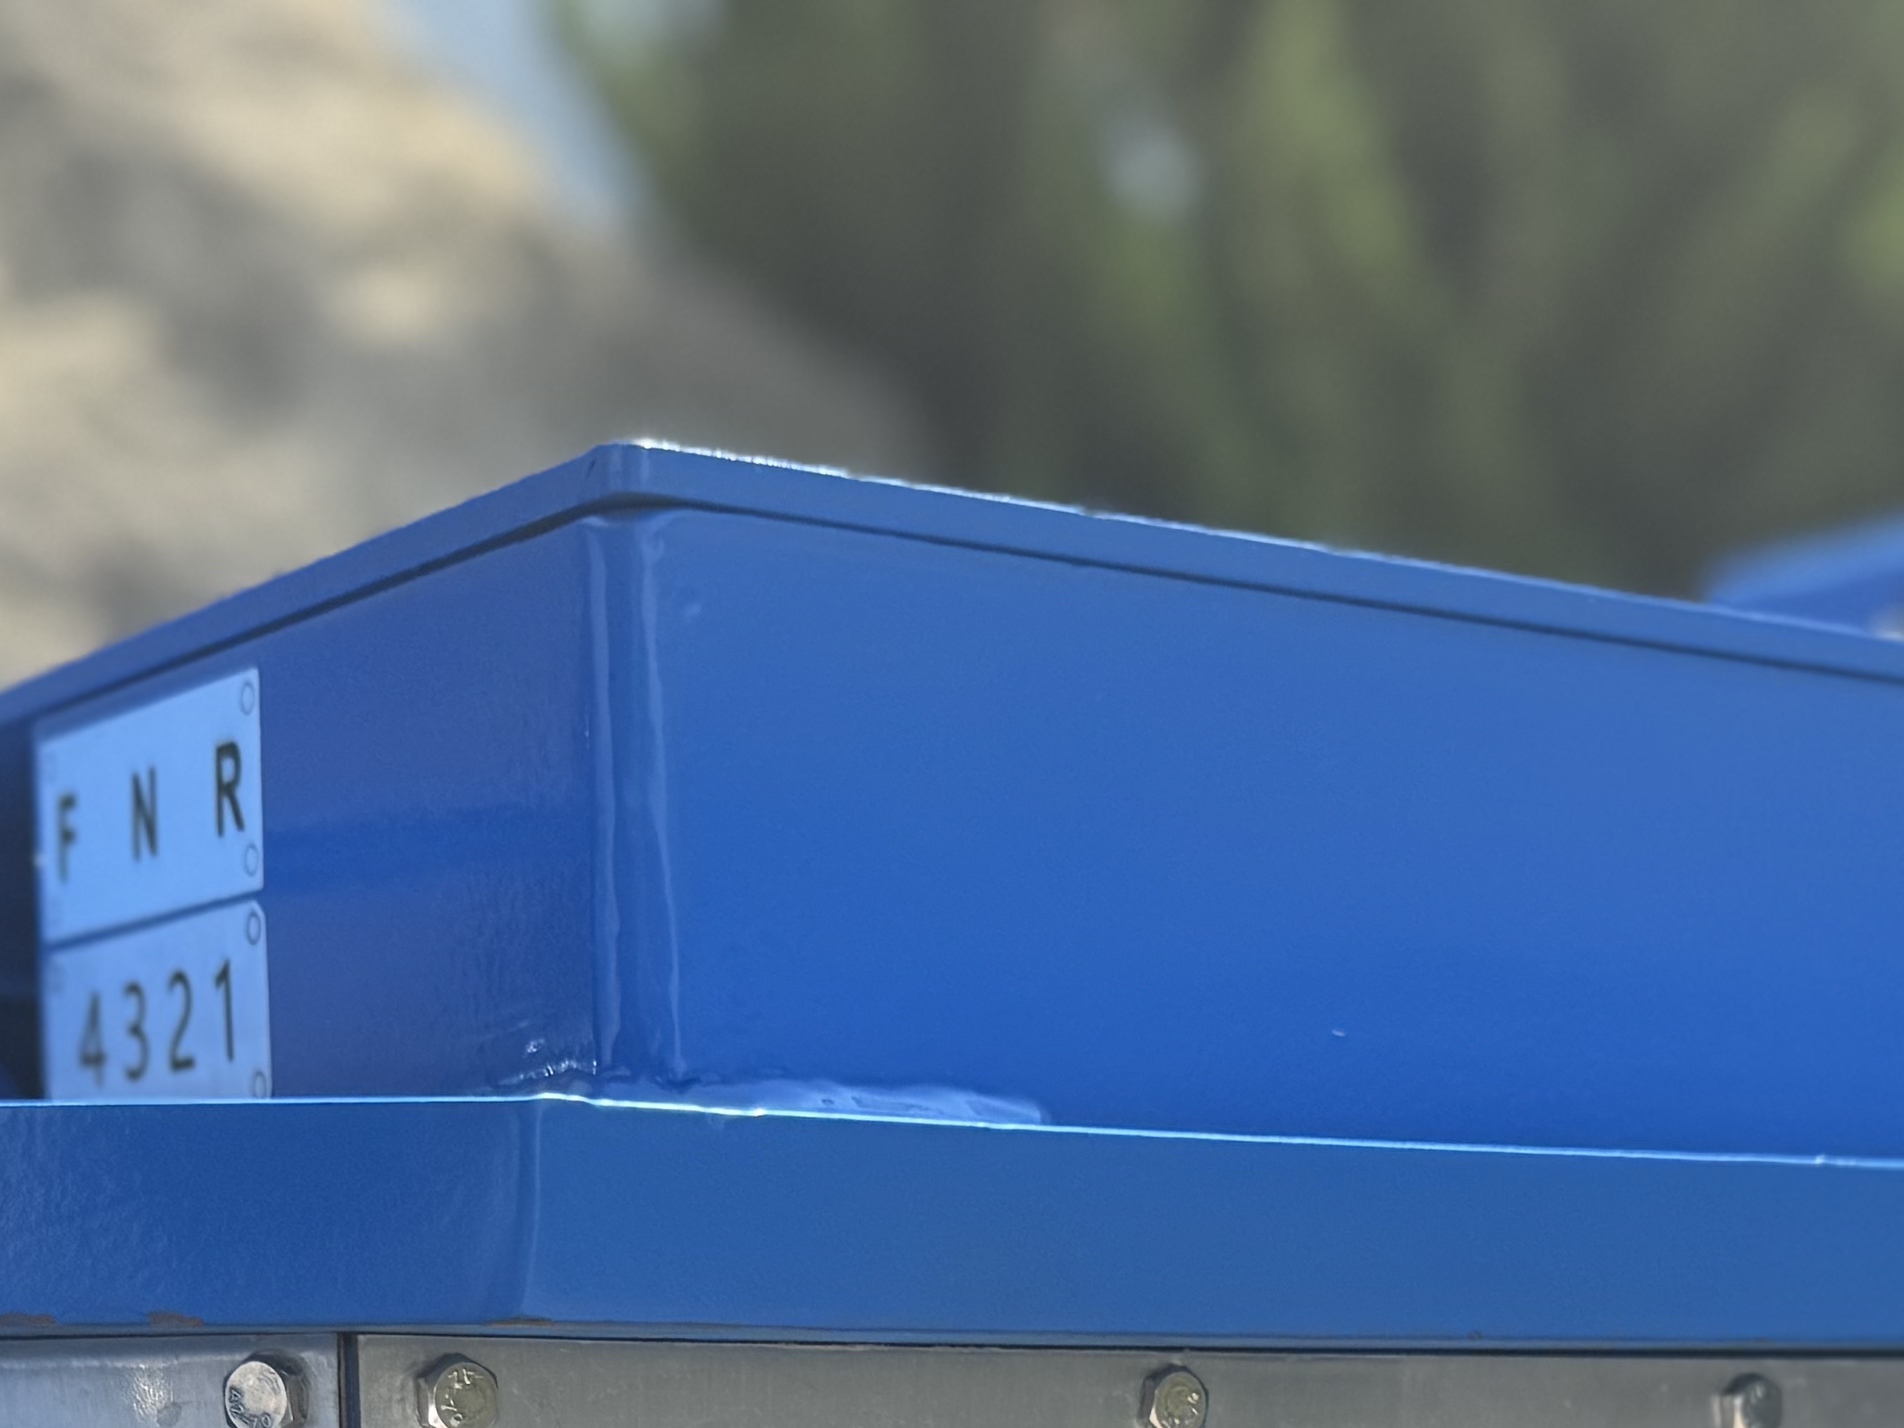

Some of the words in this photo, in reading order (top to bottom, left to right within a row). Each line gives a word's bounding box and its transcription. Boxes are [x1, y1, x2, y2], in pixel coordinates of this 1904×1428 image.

[56, 793, 77, 884] F
[132, 766, 158, 863] N
[215, 741, 244, 838] R
